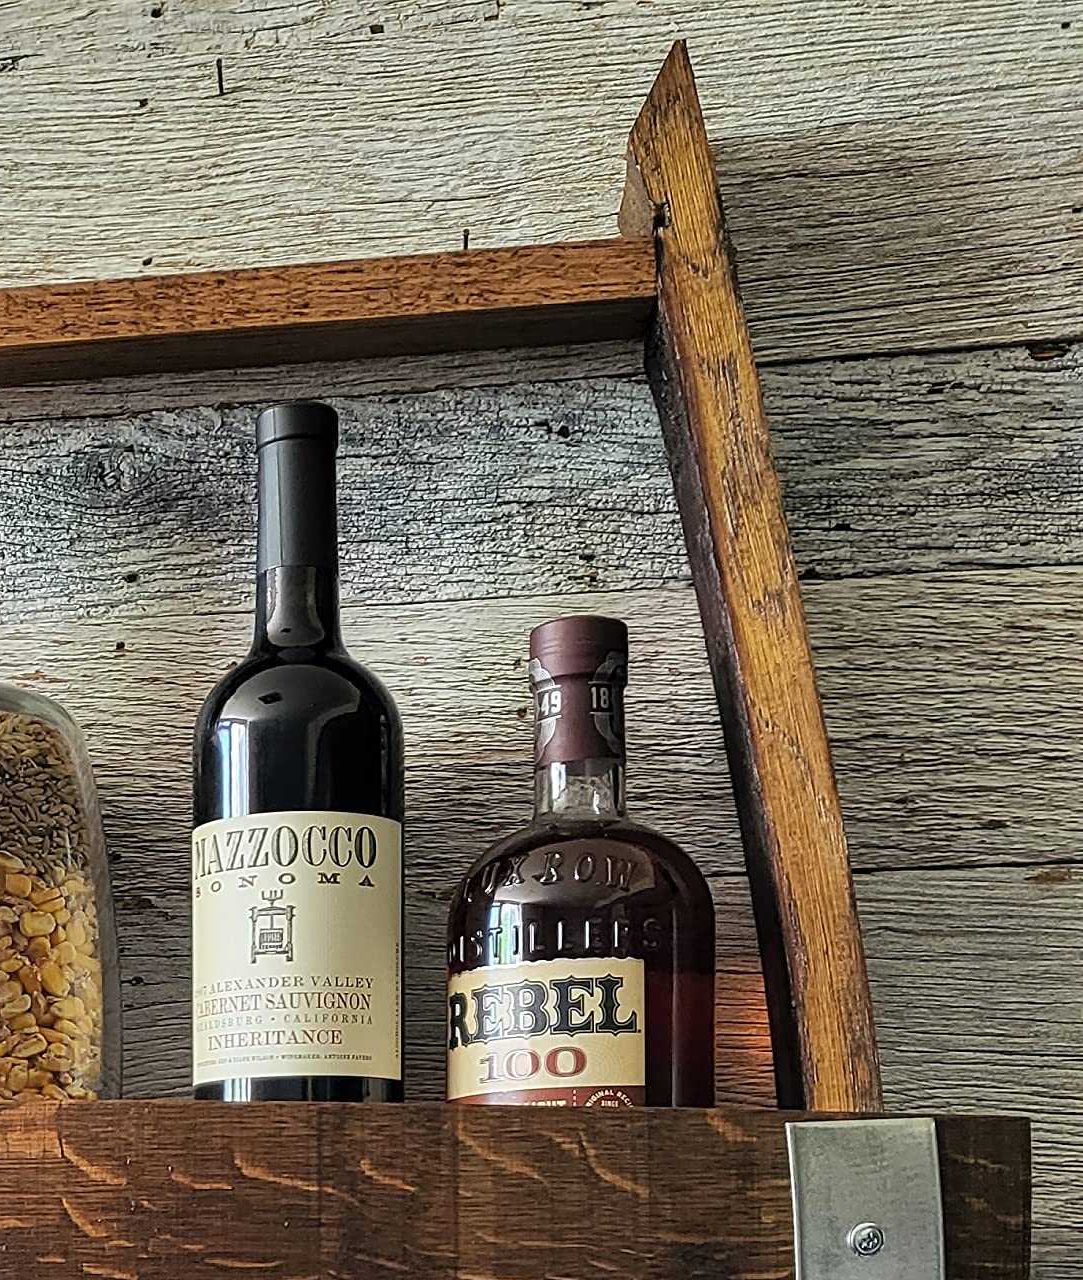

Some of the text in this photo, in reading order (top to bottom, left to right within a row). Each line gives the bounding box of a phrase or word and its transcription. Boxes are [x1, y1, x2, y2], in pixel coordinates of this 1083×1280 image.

[539, 690, 562, 716] 49
[591, 686, 609, 709] 18
[209, 976, 304, 995] ALEXANDER
[310, 975, 374, 989] VALLEY
[265, 991, 373, 1011] SAUVIGNON
[283, 1013, 373, 1025] CALIFORNIA
[208, 1029, 343, 1051] INHERITANCE
[479, 1046, 588, 1084] 100
